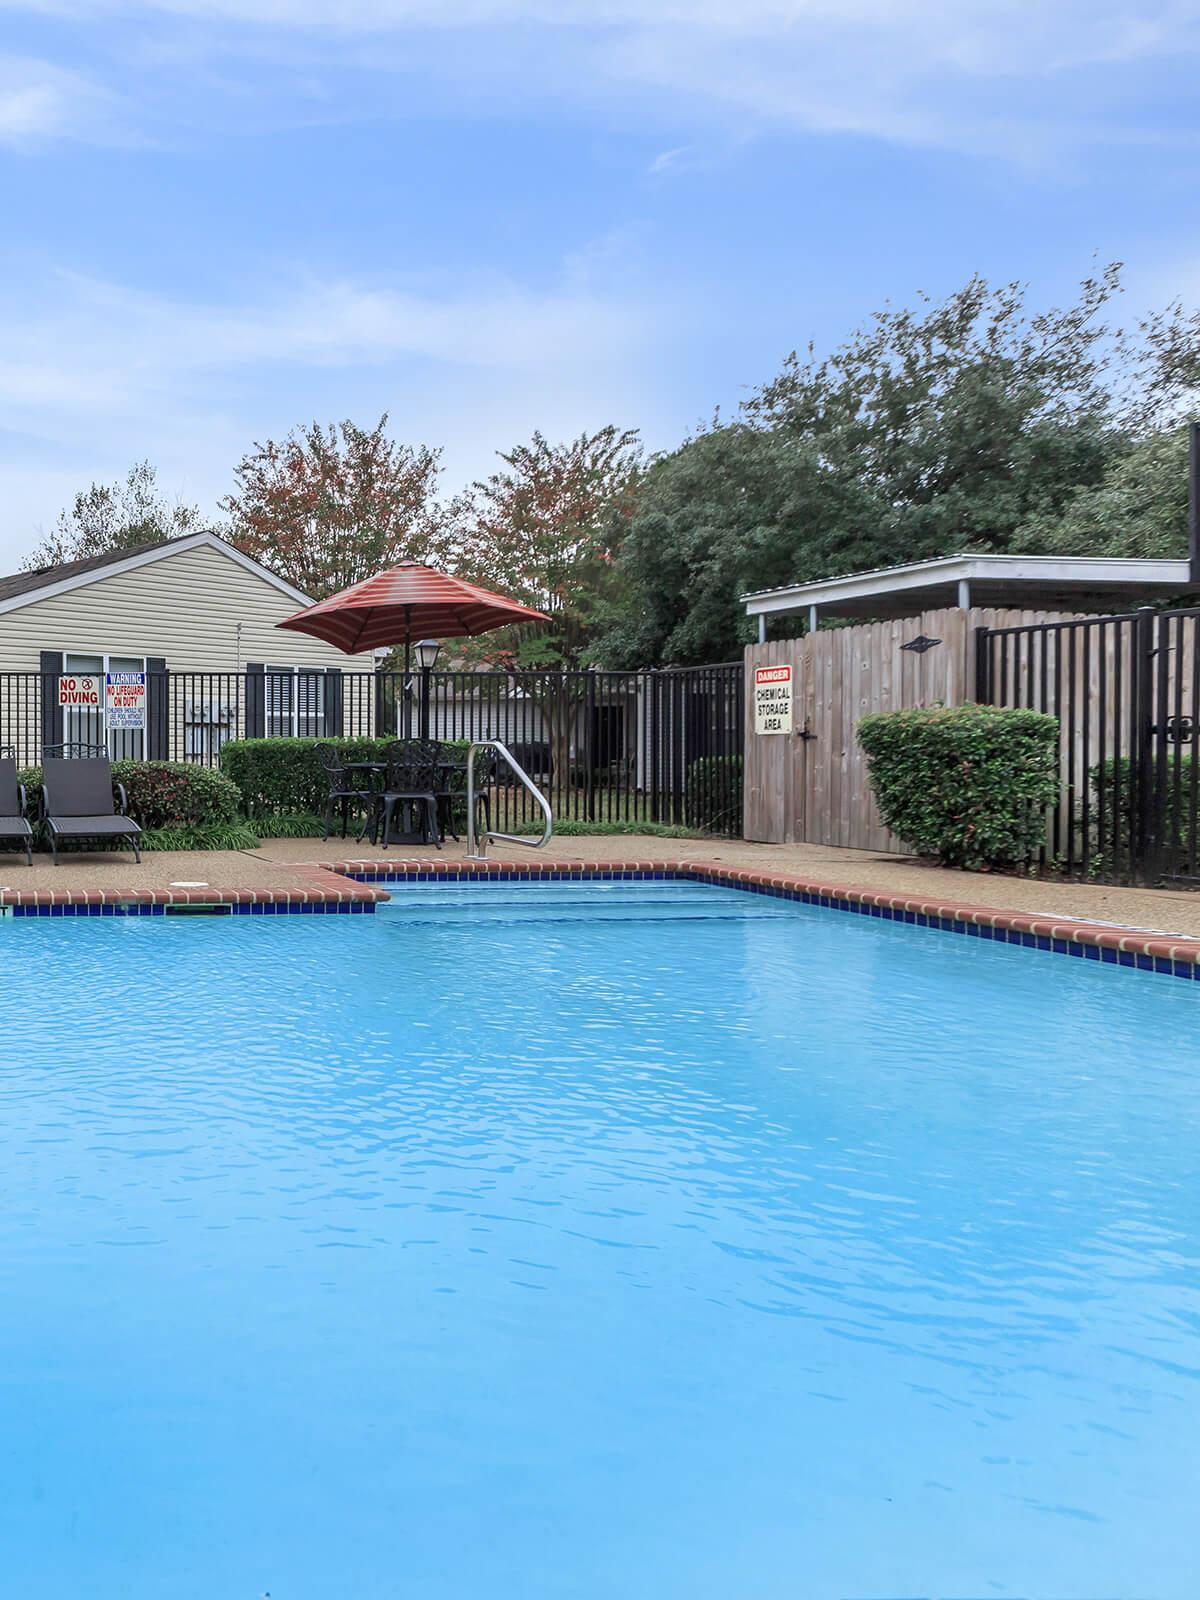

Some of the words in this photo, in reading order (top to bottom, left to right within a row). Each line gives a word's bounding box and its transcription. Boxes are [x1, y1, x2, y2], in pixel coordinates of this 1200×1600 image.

[110, 674, 142, 684] WARNING
[757, 669, 789, 682] DANGER
[60, 679, 76, 691] NO
[107, 686, 114, 696] NO
[116, 686, 144, 696] LIFEGUARD
[60, 691, 98, 704] DIVING
[757, 688, 790, 701] CHEMICAL
[114, 697, 122, 707] ON
[123, 697, 138, 707] DUTY
[758, 702, 789, 716] STORAGE
[764, 718, 782, 730] AREA
